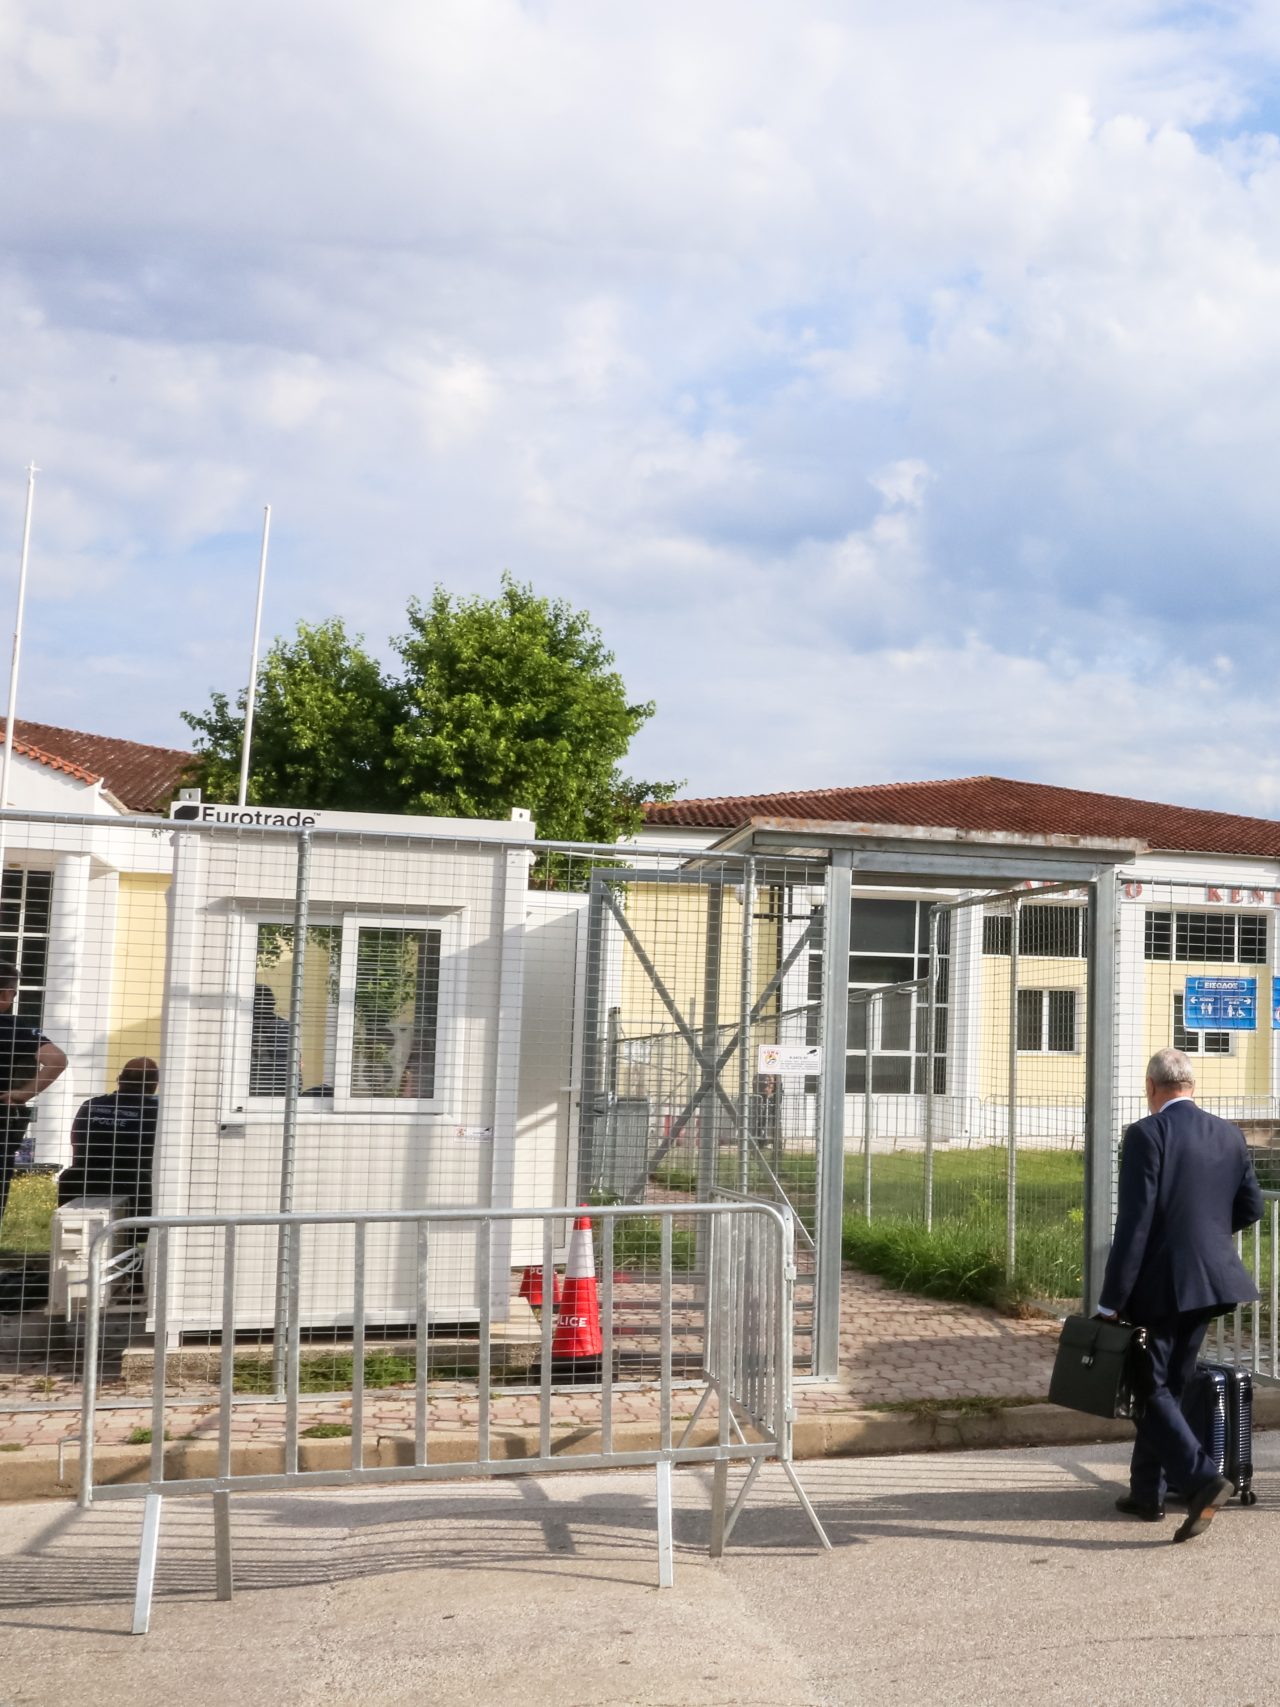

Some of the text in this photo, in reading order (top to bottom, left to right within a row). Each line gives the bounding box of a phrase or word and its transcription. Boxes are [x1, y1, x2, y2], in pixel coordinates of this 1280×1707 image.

[202, 806, 316, 828] Eurotrade
[1204, 981, 1239, 989] ΕΙΣΟΔΟΣ
[557, 1315, 588, 1327] LICE
